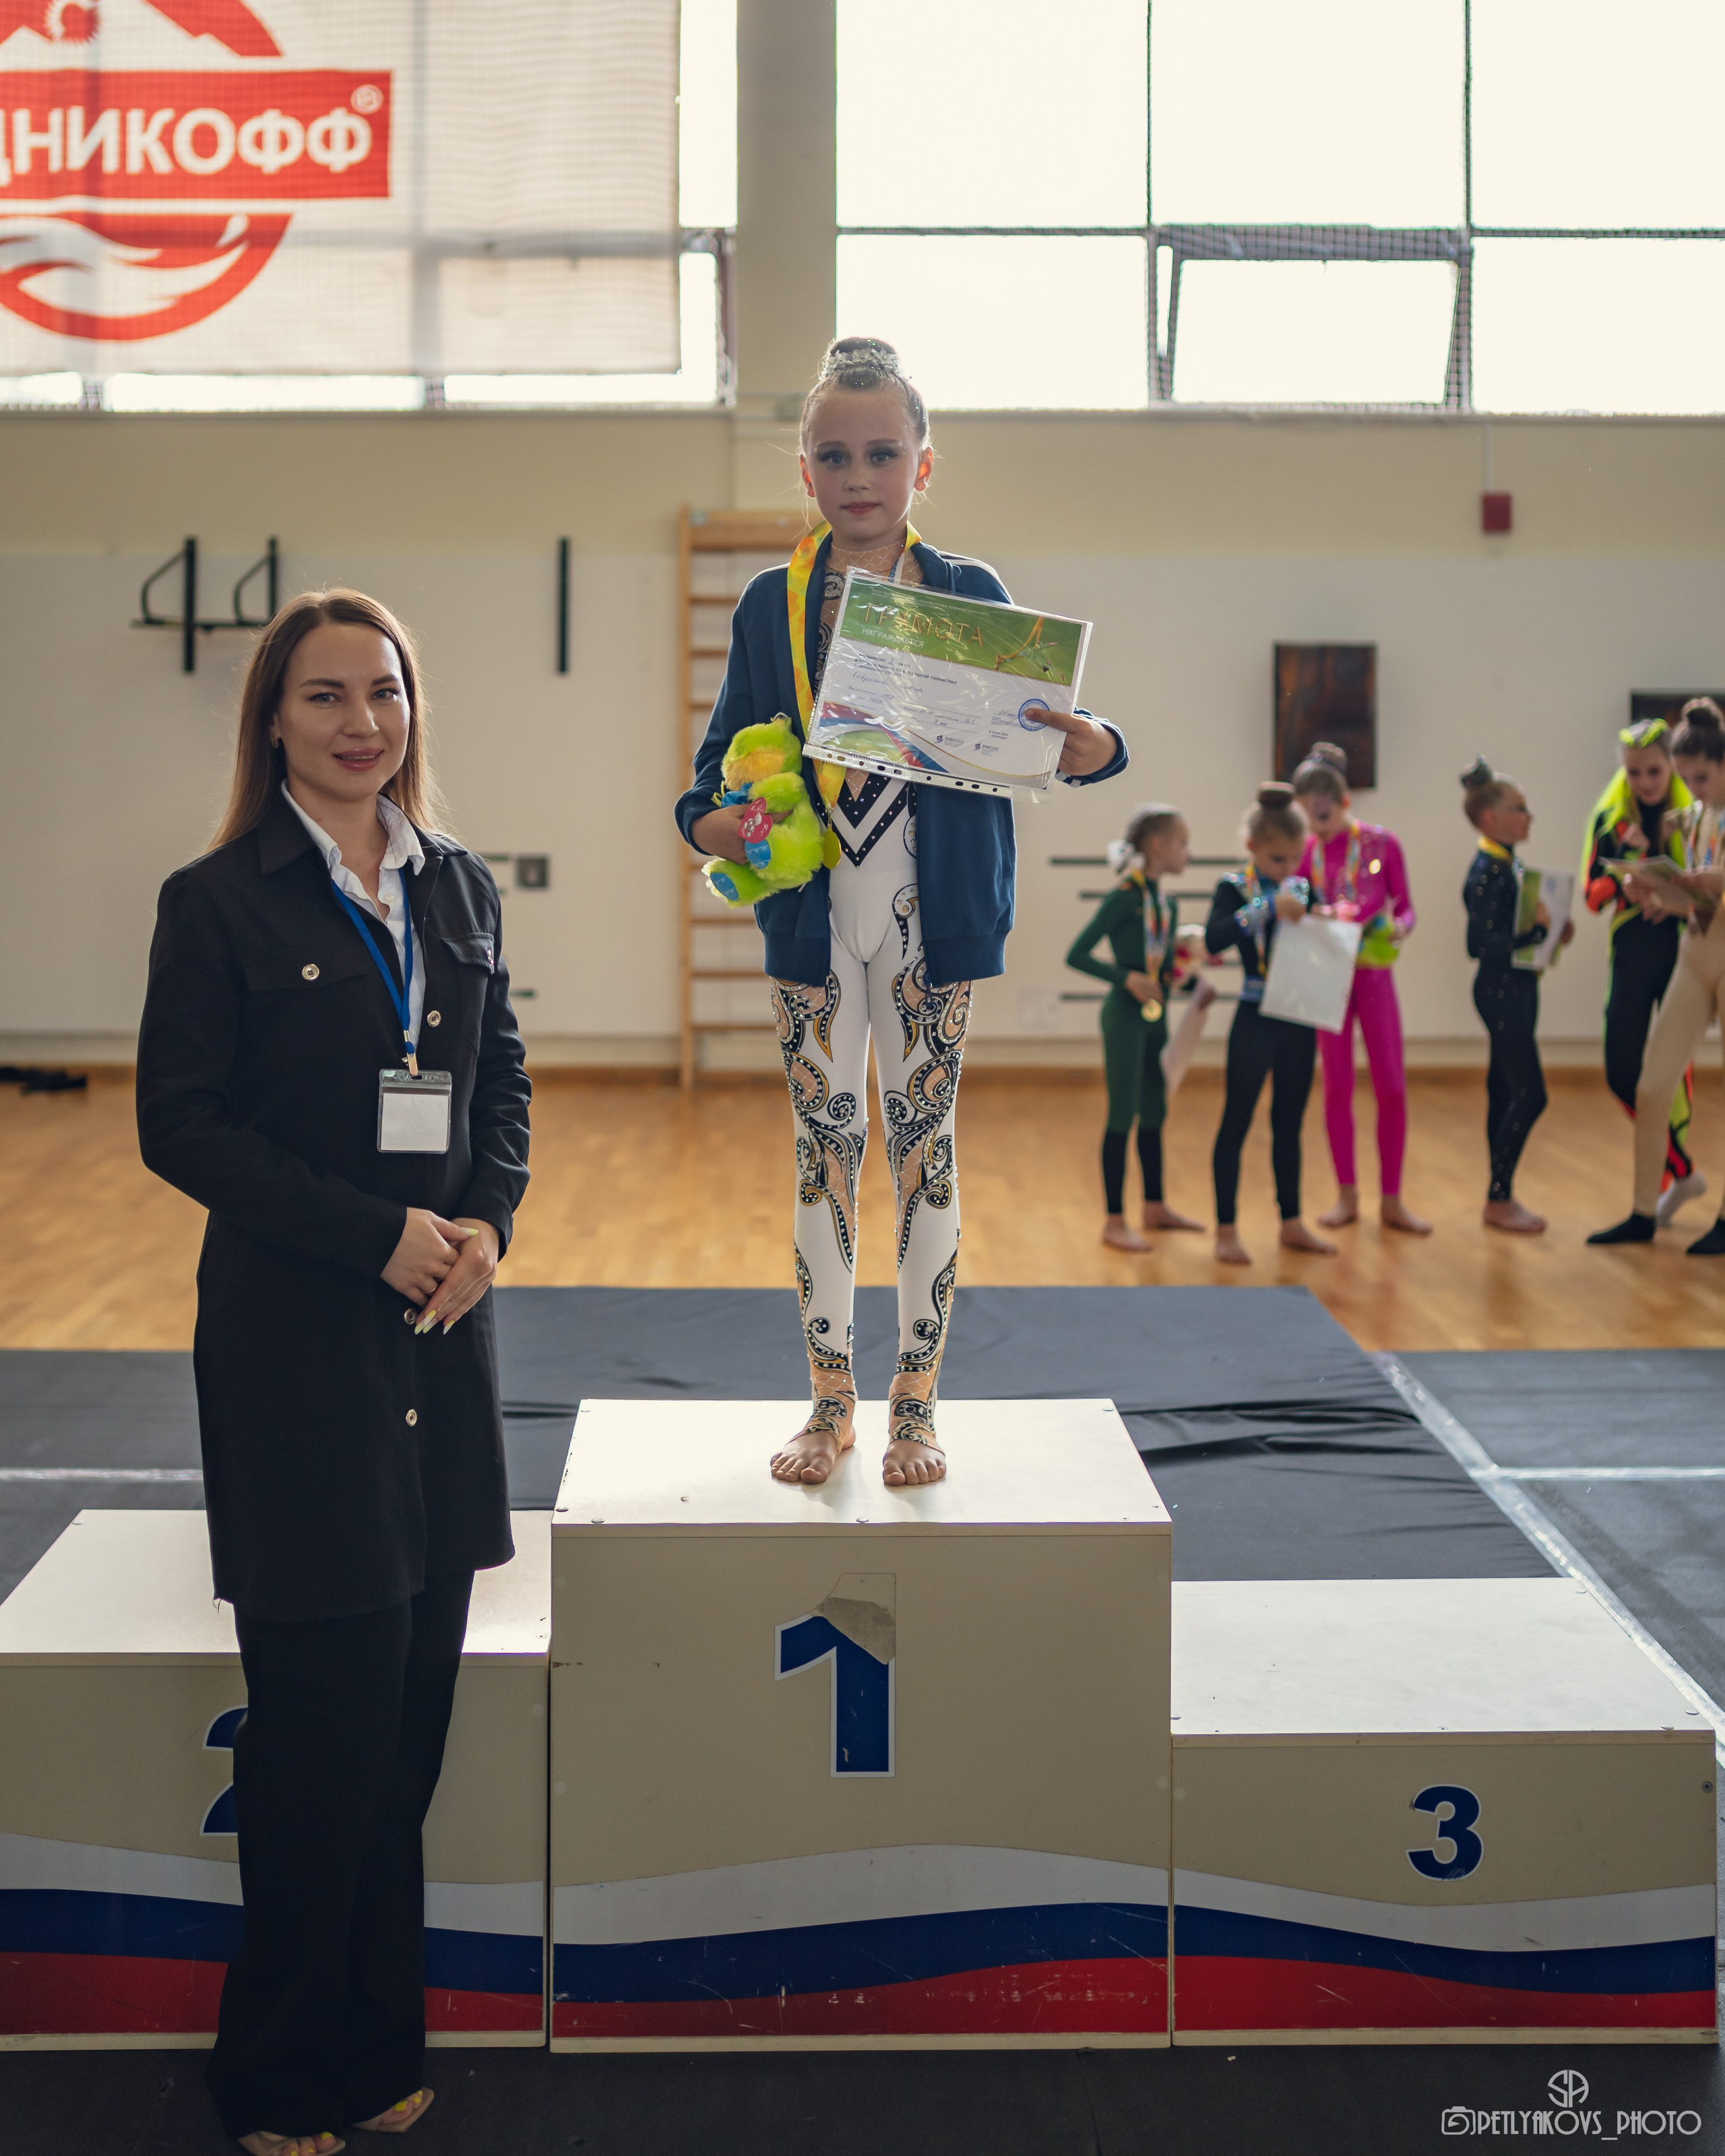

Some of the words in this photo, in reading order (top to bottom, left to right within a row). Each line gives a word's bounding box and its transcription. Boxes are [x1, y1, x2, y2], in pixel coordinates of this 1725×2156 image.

[862, 628, 924, 648] НАГРАЖДАЕТСЯ
[865, 603, 983, 647] ГРАМОТА
[930, 676, 958, 685] ГИМНАСТИКЕ
[945, 736, 964, 744] ОФСОО
[775, 1613, 896, 1778] 1
[1405, 1783, 1484, 1881] 3
